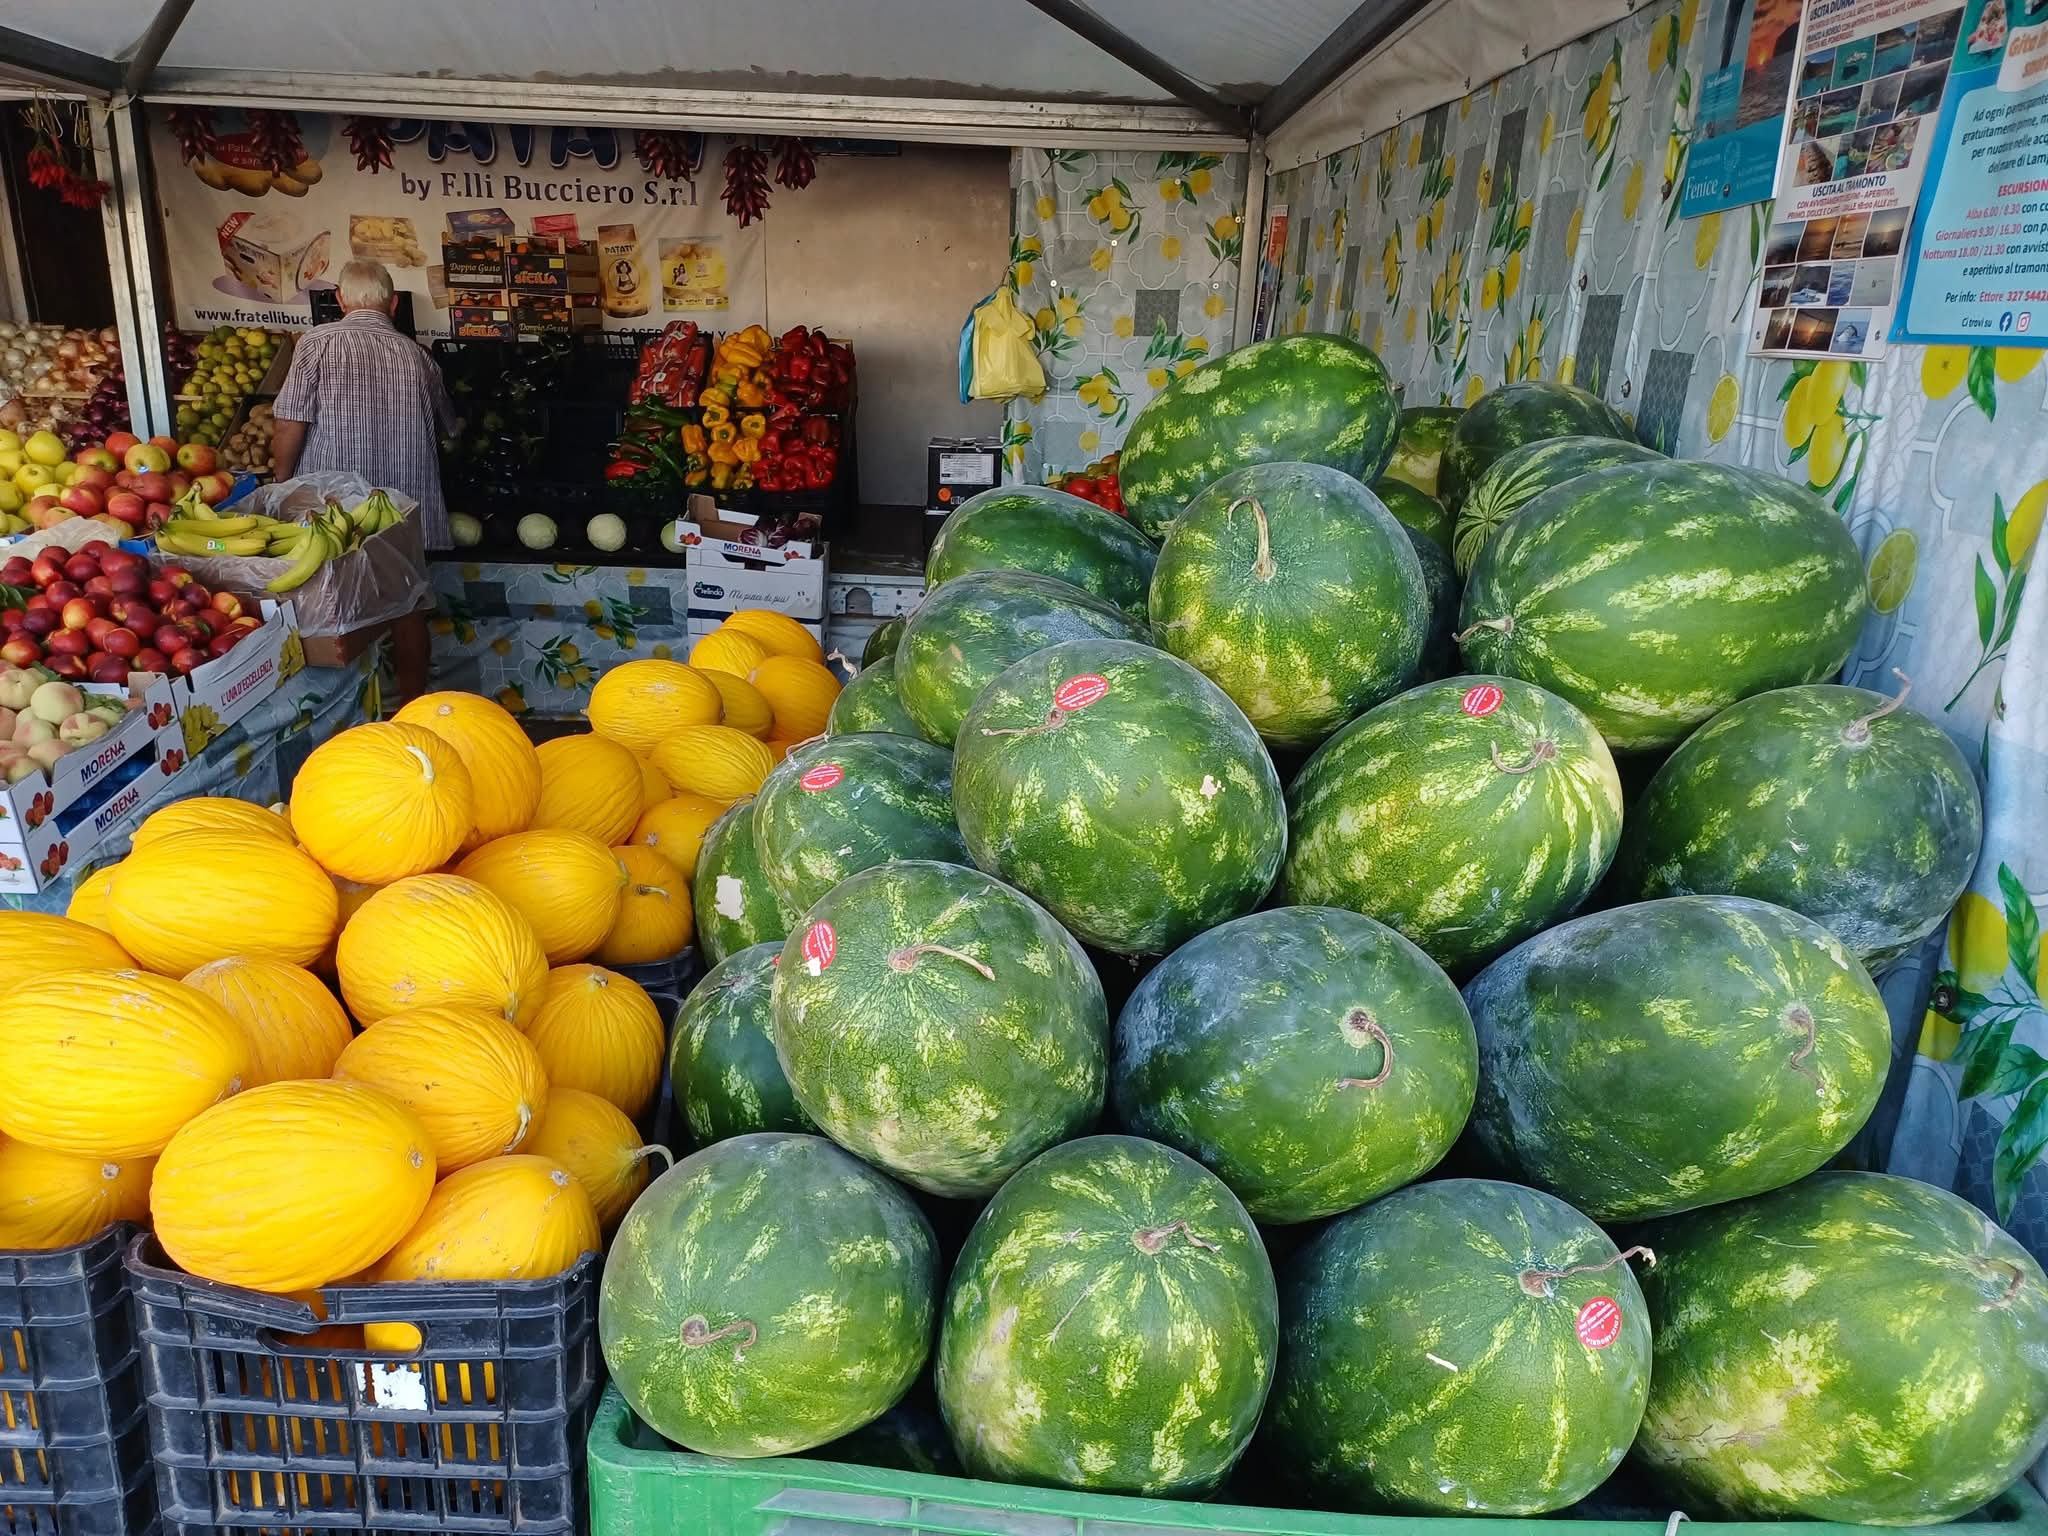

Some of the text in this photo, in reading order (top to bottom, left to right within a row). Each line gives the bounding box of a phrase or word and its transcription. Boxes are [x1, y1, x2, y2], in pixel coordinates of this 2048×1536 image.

[1973, 108, 1985, 122] Ad
[1985, 103, 2005, 122] ogni
[1971, 147, 1986, 161] per
[2017, 153, 2025, 168] di
[401, 171, 432, 201] by
[440, 172, 495, 199] F.lli
[504, 175, 634, 205] Bucciero
[1685, 175, 1719, 201] Fenice
[1812, 183, 1838, 198] USCITA
[2021, 203, 2037, 214] con
[220, 215, 240, 241] NEW
[1936, 227, 1978, 242] Giornaliera
[2022, 224, 2039, 234] con
[1923, 249, 1957, 261] Notturna
[2006, 244, 2022, 255] con
[1963, 267, 1969, 277] e
[1969, 263, 2004, 279] aperitivo
[2004, 261, 2014, 275] al
[1945, 291, 1958, 303] Per
[1959, 290, 1977, 303] info:
[2006, 290, 2024, 302] 327
[2024, 290, 2048, 302] 5442
[723, 542, 762, 556] MORENA
[729, 589, 742, 599] Mi
[80, 739, 126, 783] MORENA
[94, 786, 140, 832] MORENA
